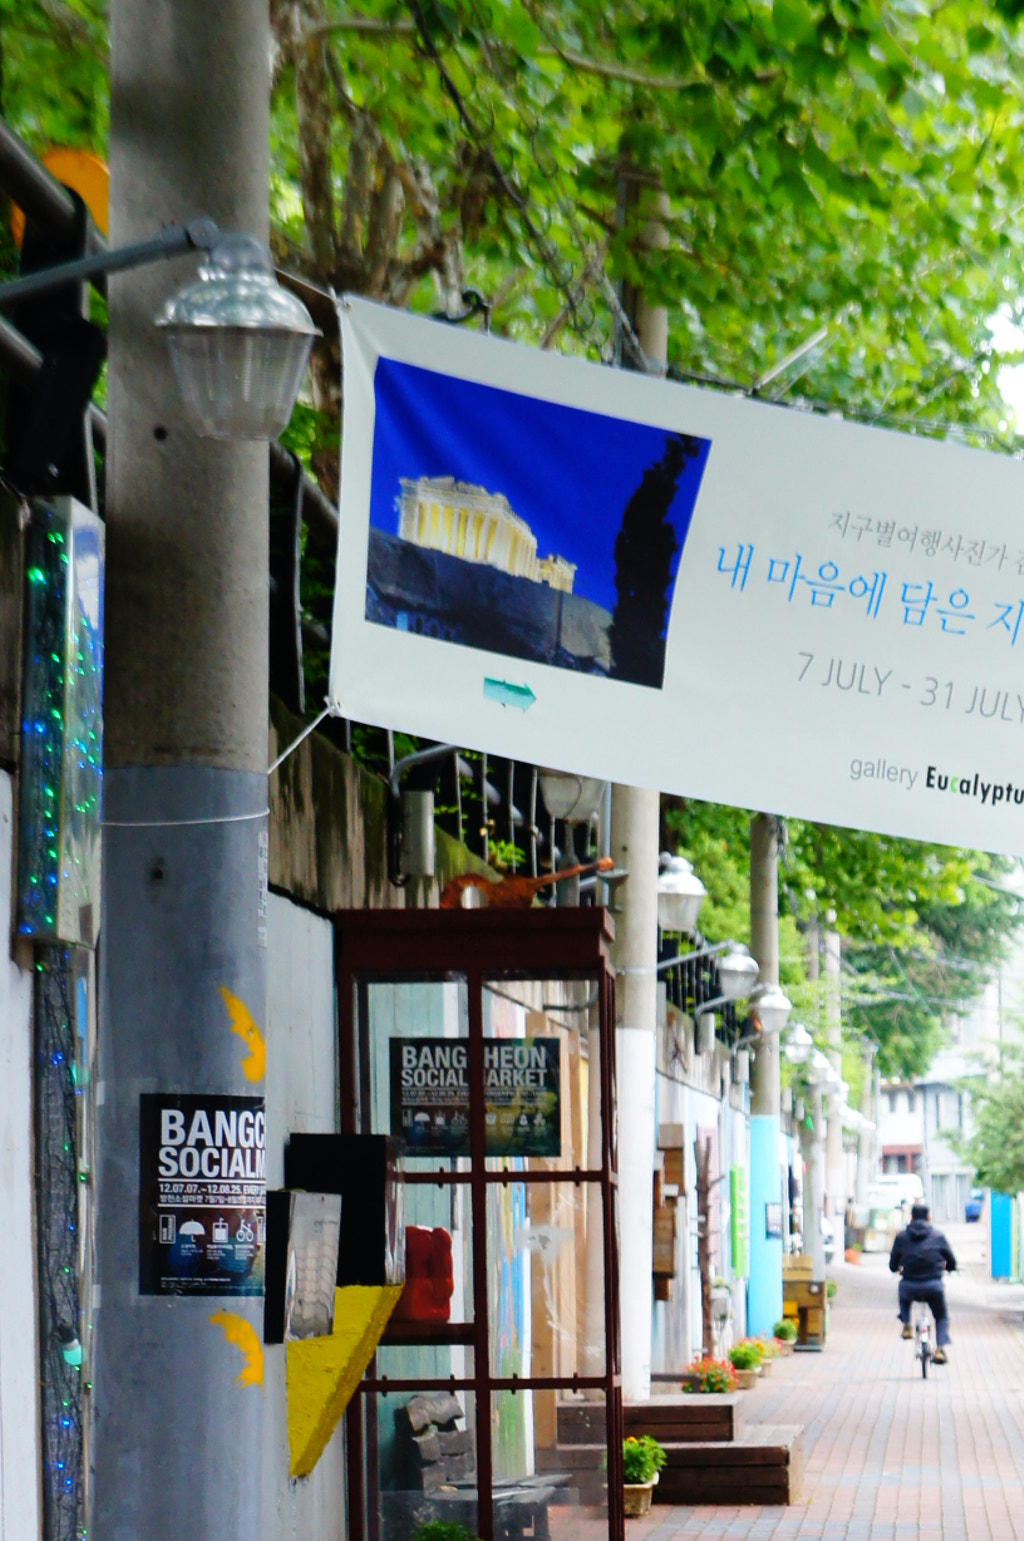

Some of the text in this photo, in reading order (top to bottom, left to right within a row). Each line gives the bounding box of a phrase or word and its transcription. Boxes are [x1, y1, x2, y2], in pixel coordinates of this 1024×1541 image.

[828, 511, 1008, 571] 지구별여행사진가
[717, 543, 754, 592] 내
[767, 553, 888, 620] 마음에
[900, 580, 976, 636] 담은
[797, 652, 815, 683] 7
[820, 658, 894, 697] JULY
[920, 676, 955, 710] 31
[849, 758, 919, 791] gallery
[402, 1045, 547, 1070] BANGHEON
